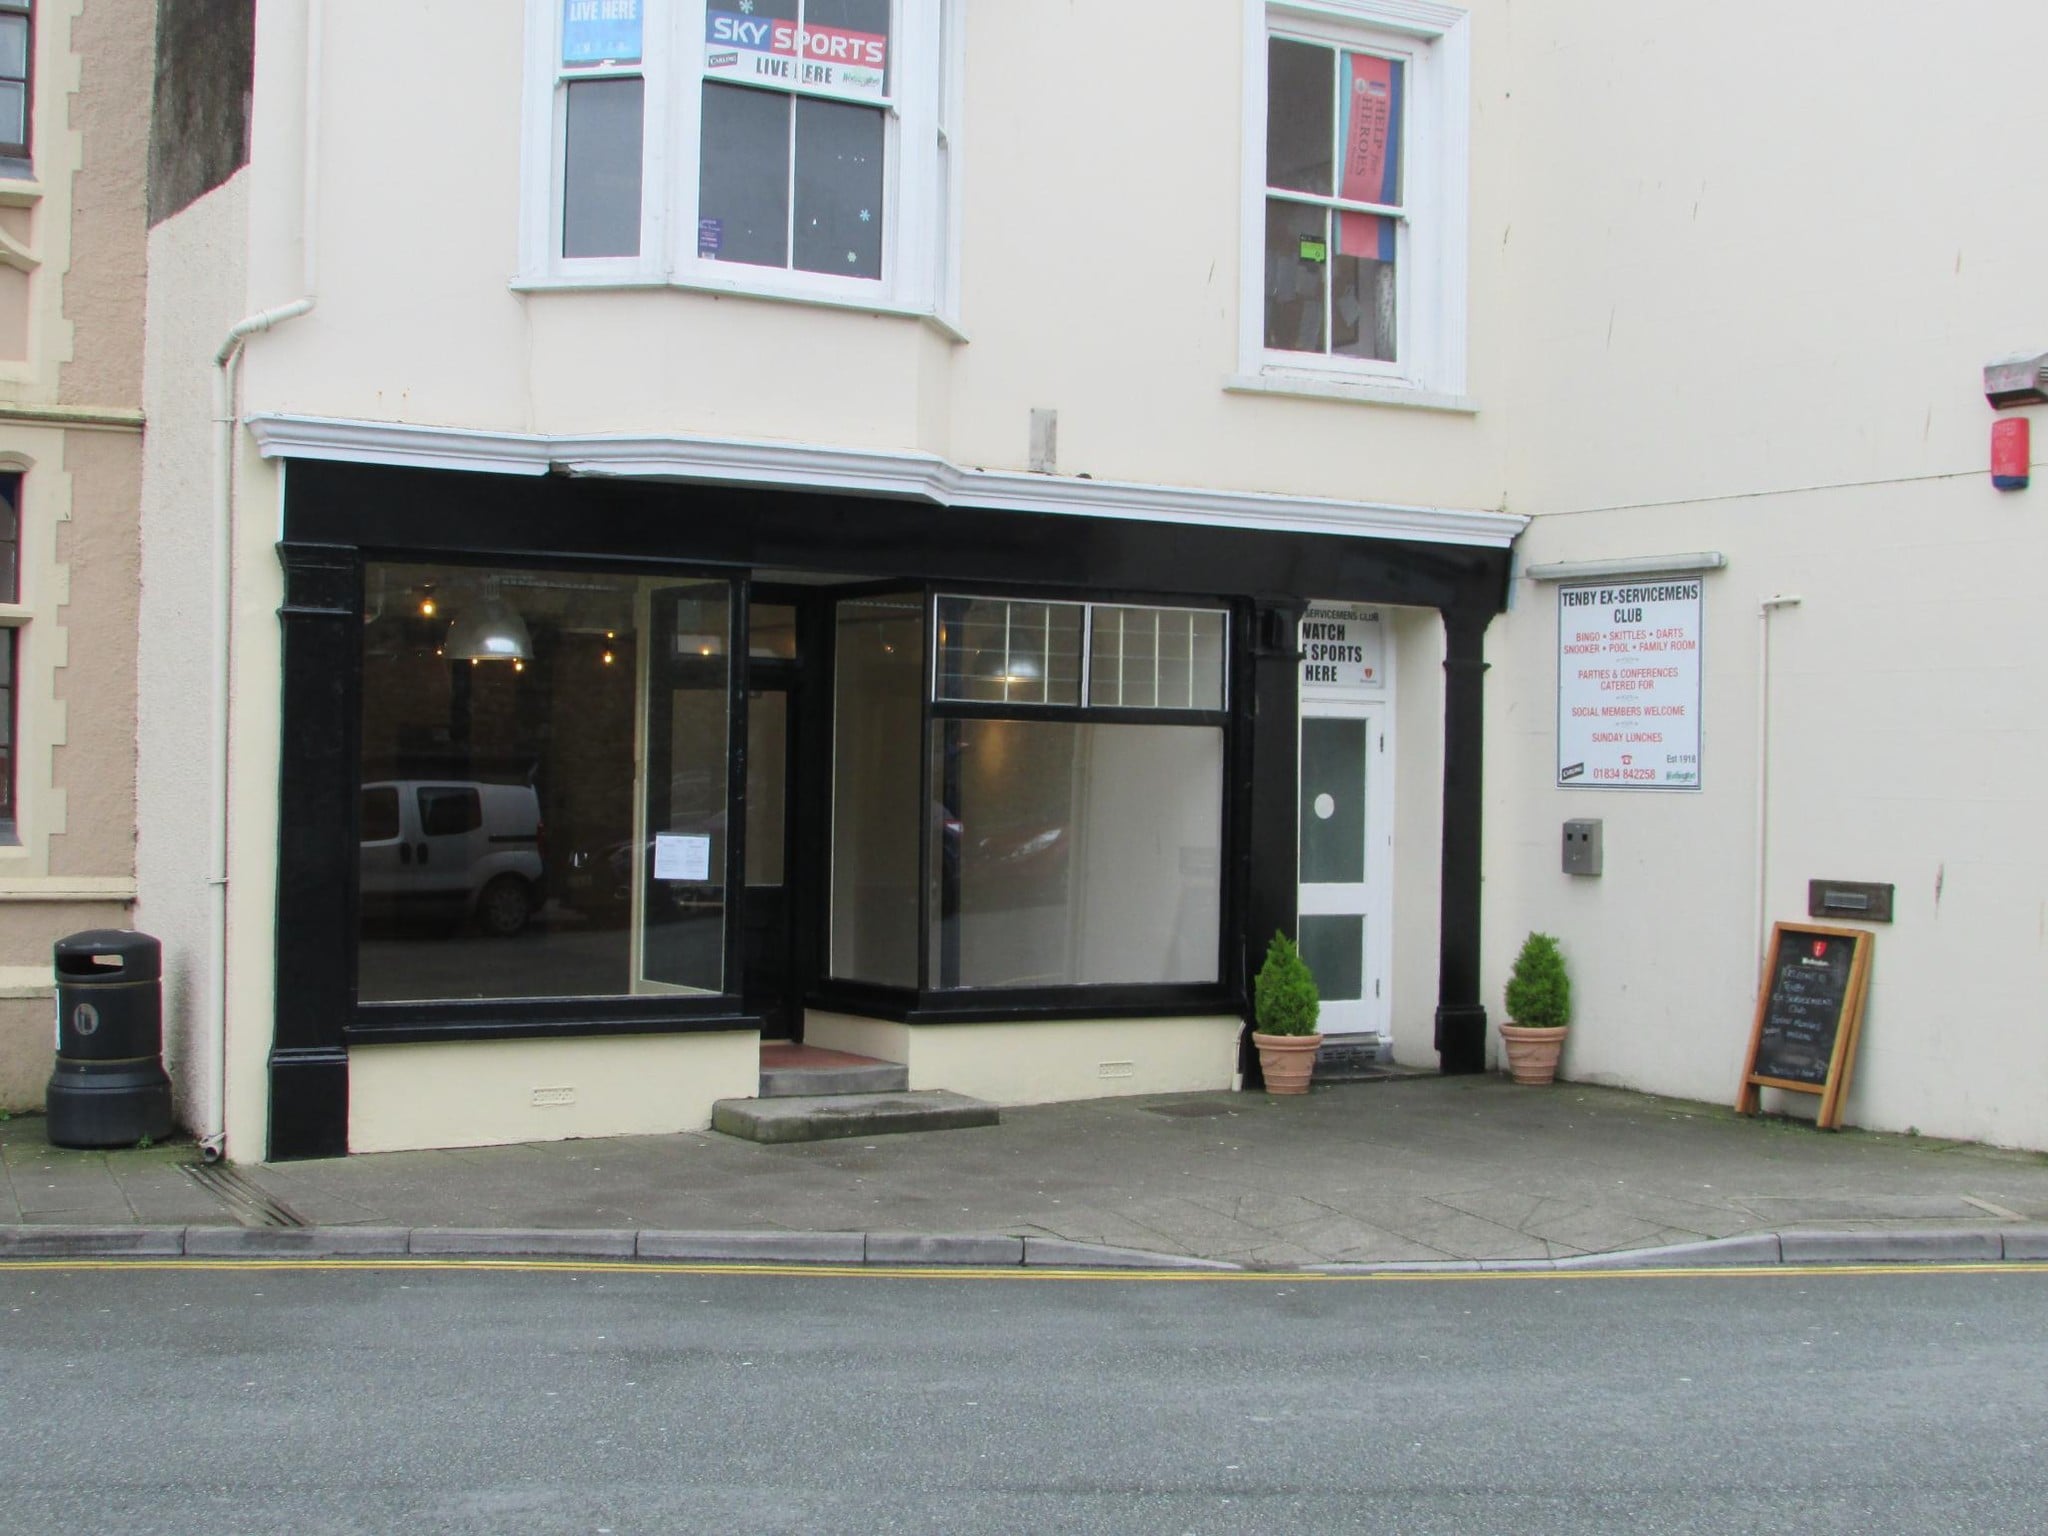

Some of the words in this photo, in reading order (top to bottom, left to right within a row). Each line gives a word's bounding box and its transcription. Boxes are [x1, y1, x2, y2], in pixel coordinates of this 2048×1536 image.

[569, 1, 599, 21] LIVE
[601, 0, 637, 20] HERE
[713, 16, 768, 45] SKY
[774, 27, 883, 63] SPORTS
[756, 56, 790, 78] LIVE
[1374, 96, 1386, 150] HELP
[1356, 96, 1373, 176] HEROES
[1563, 591, 1597, 607] TENBY
[1600, 584, 1699, 605] EX-SERVICEMENS
[1614, 607, 1642, 623] CLUB
[1576, 632, 1600, 642] BINGO
[1609, 630, 1647, 641] SKITTLES
[1656, 628, 1684, 639] DARTS
[1311, 643, 1362, 663] SPORTS
[1563, 643, 1600, 655] SNOOKER
[1609, 643, 1630, 653] POOL
[1640, 641, 1668, 652] FAMILY
[1671, 640, 1696, 651] ROOM
[1305, 664, 1337, 682] HERE
[1578, 669, 1611, 680] PARTIES
[1620, 667, 1679, 679] CONFERENCES
[1600, 680, 1636, 691] CATERED
[1638, 680, 1655, 690] FOR
[1572, 706, 1599, 717] SOCIAL
[1601, 706, 1642, 717] MEMBERS
[1644, 705, 1686, 716] WELCOME
[1592, 732, 1624, 743] SUNDAY
[1626, 732, 1663, 743] LUNCHES
[1666, 754, 1678, 764] Est
[1593, 767, 1620, 779] 01834
